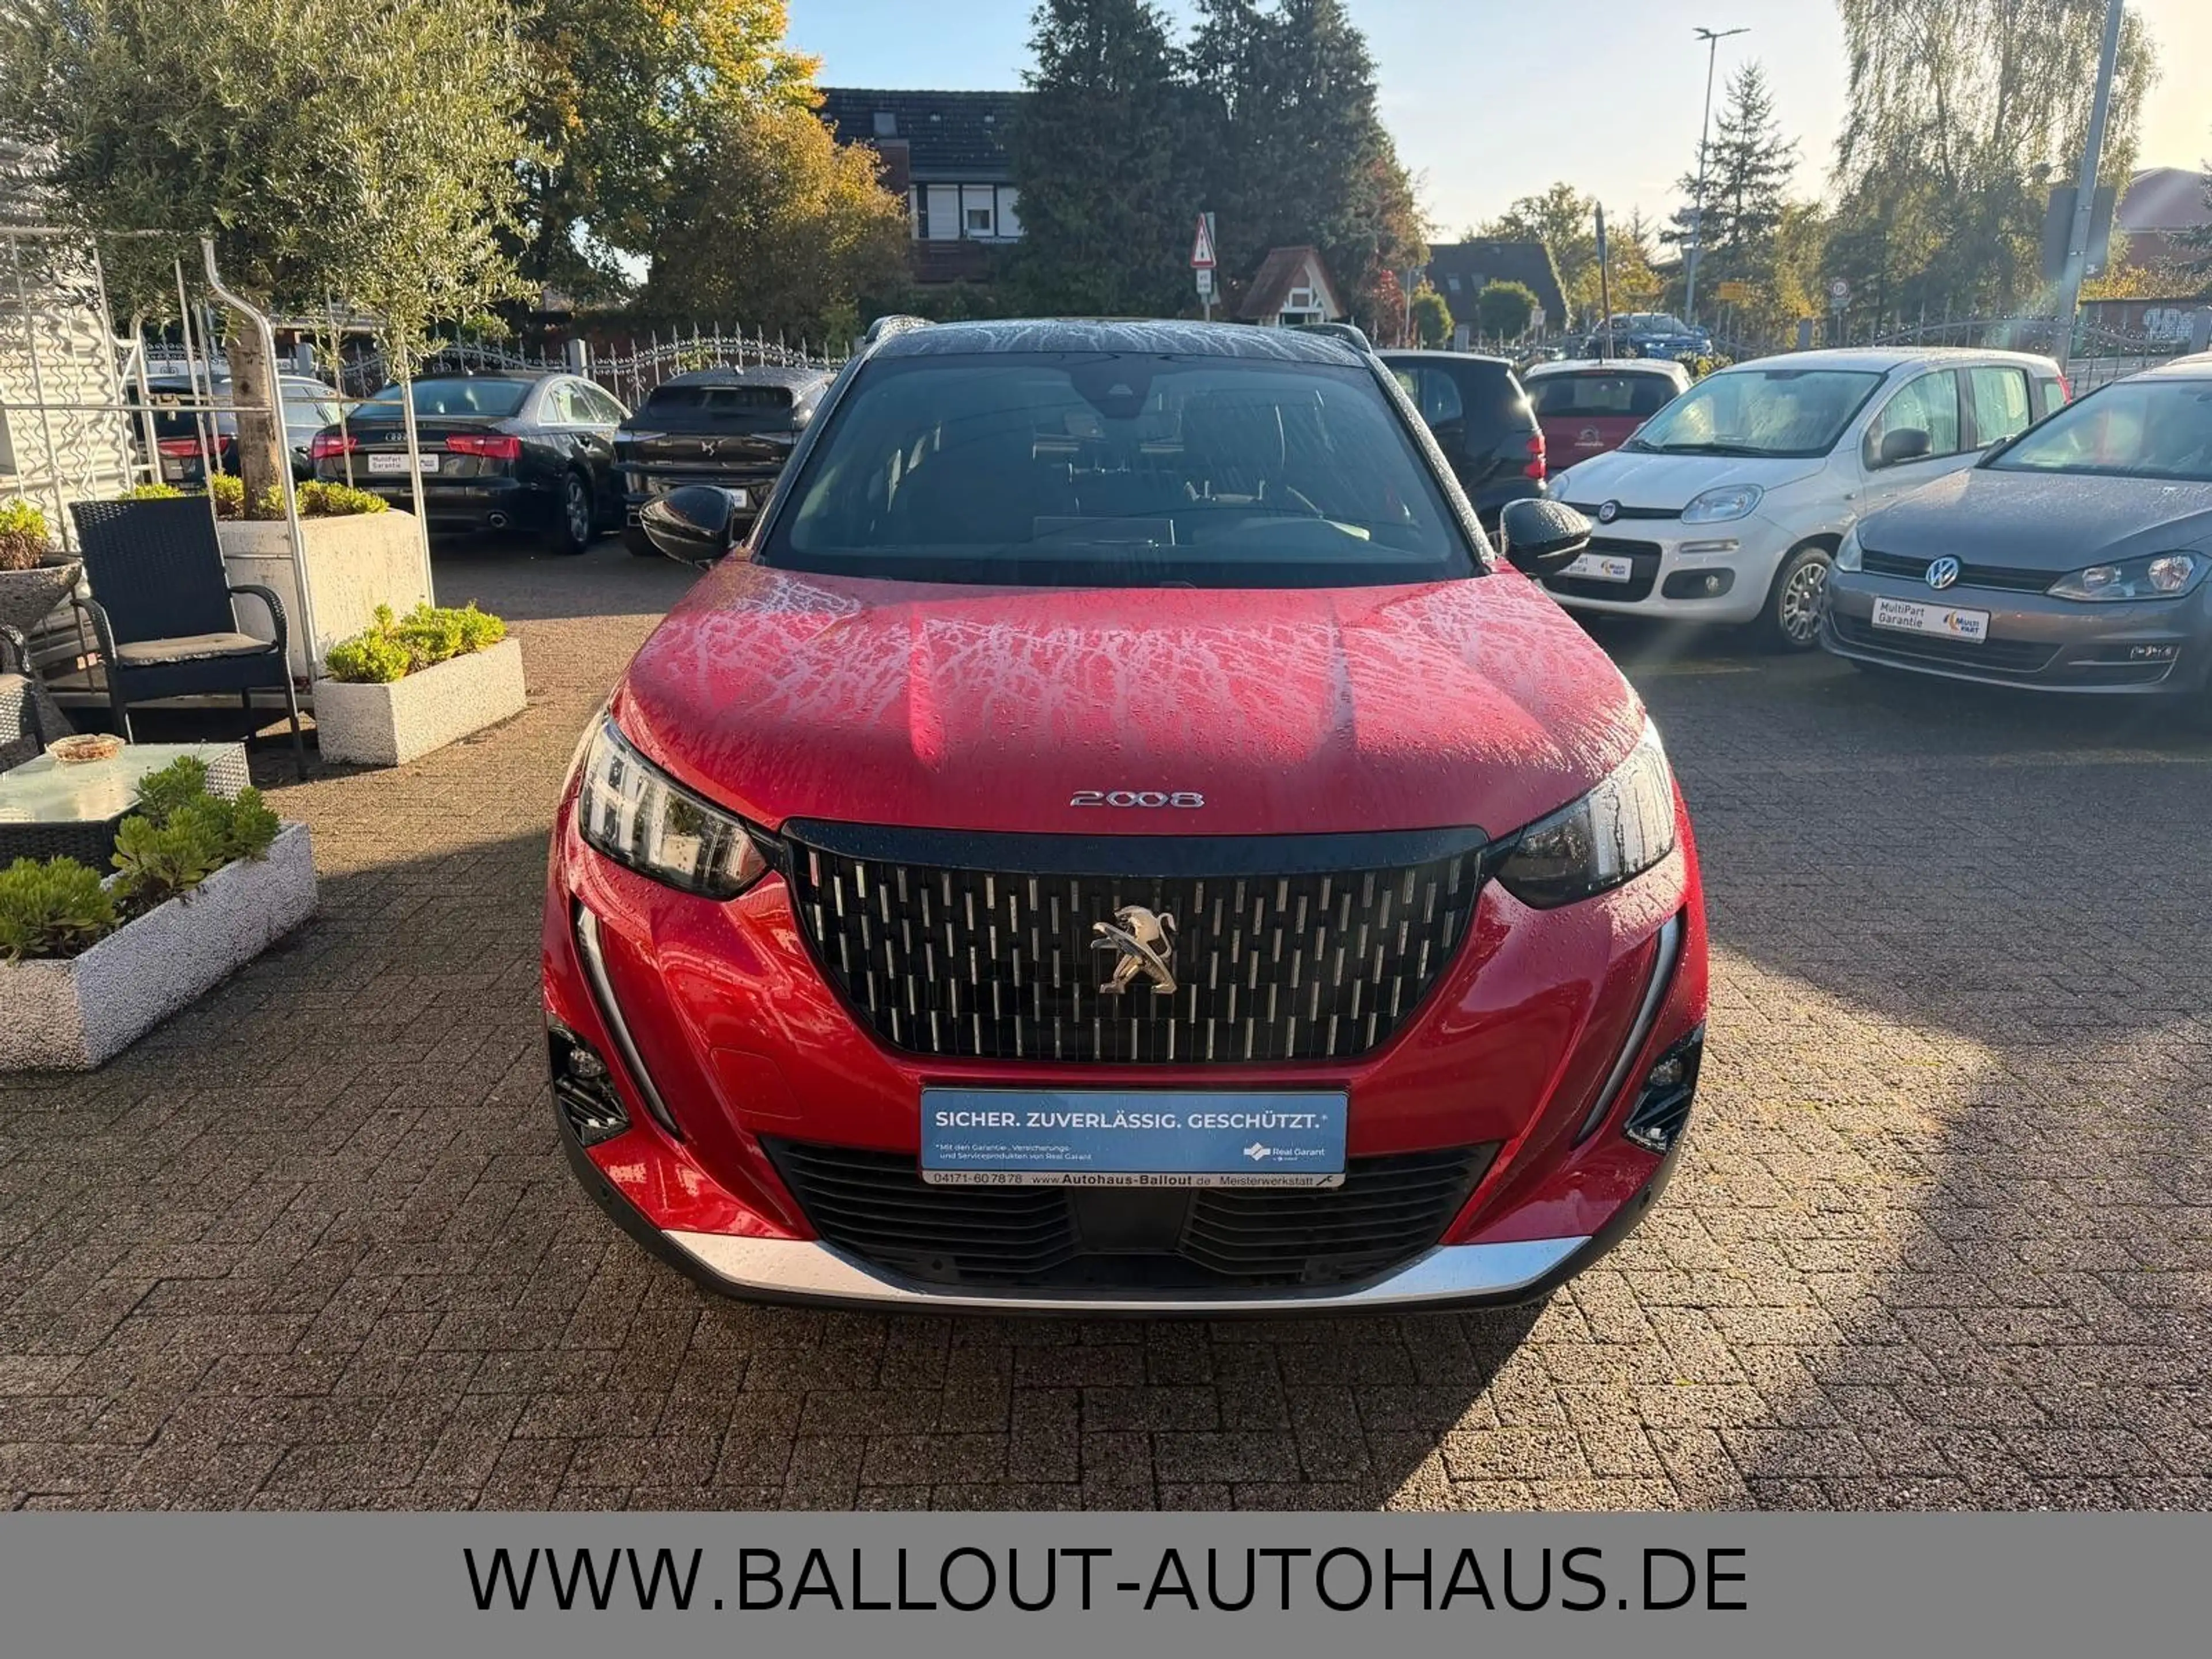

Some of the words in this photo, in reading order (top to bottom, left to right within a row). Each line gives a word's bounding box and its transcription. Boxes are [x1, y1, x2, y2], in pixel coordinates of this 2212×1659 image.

[1880, 602, 1925, 617] MultiPart
[1878, 612, 1923, 628] Garantie
[1070, 790, 1205, 808] 2008
[935, 1112, 1021, 1127] SICHER.
[1027, 1109, 1181, 1128] ZUVERLÄSSIG.
[1272, 1147, 1293, 1156] Real
[1294, 1147, 1325, 1156] Garant
[1220, 1175, 1313, 1186] Meisterwerkstatt
